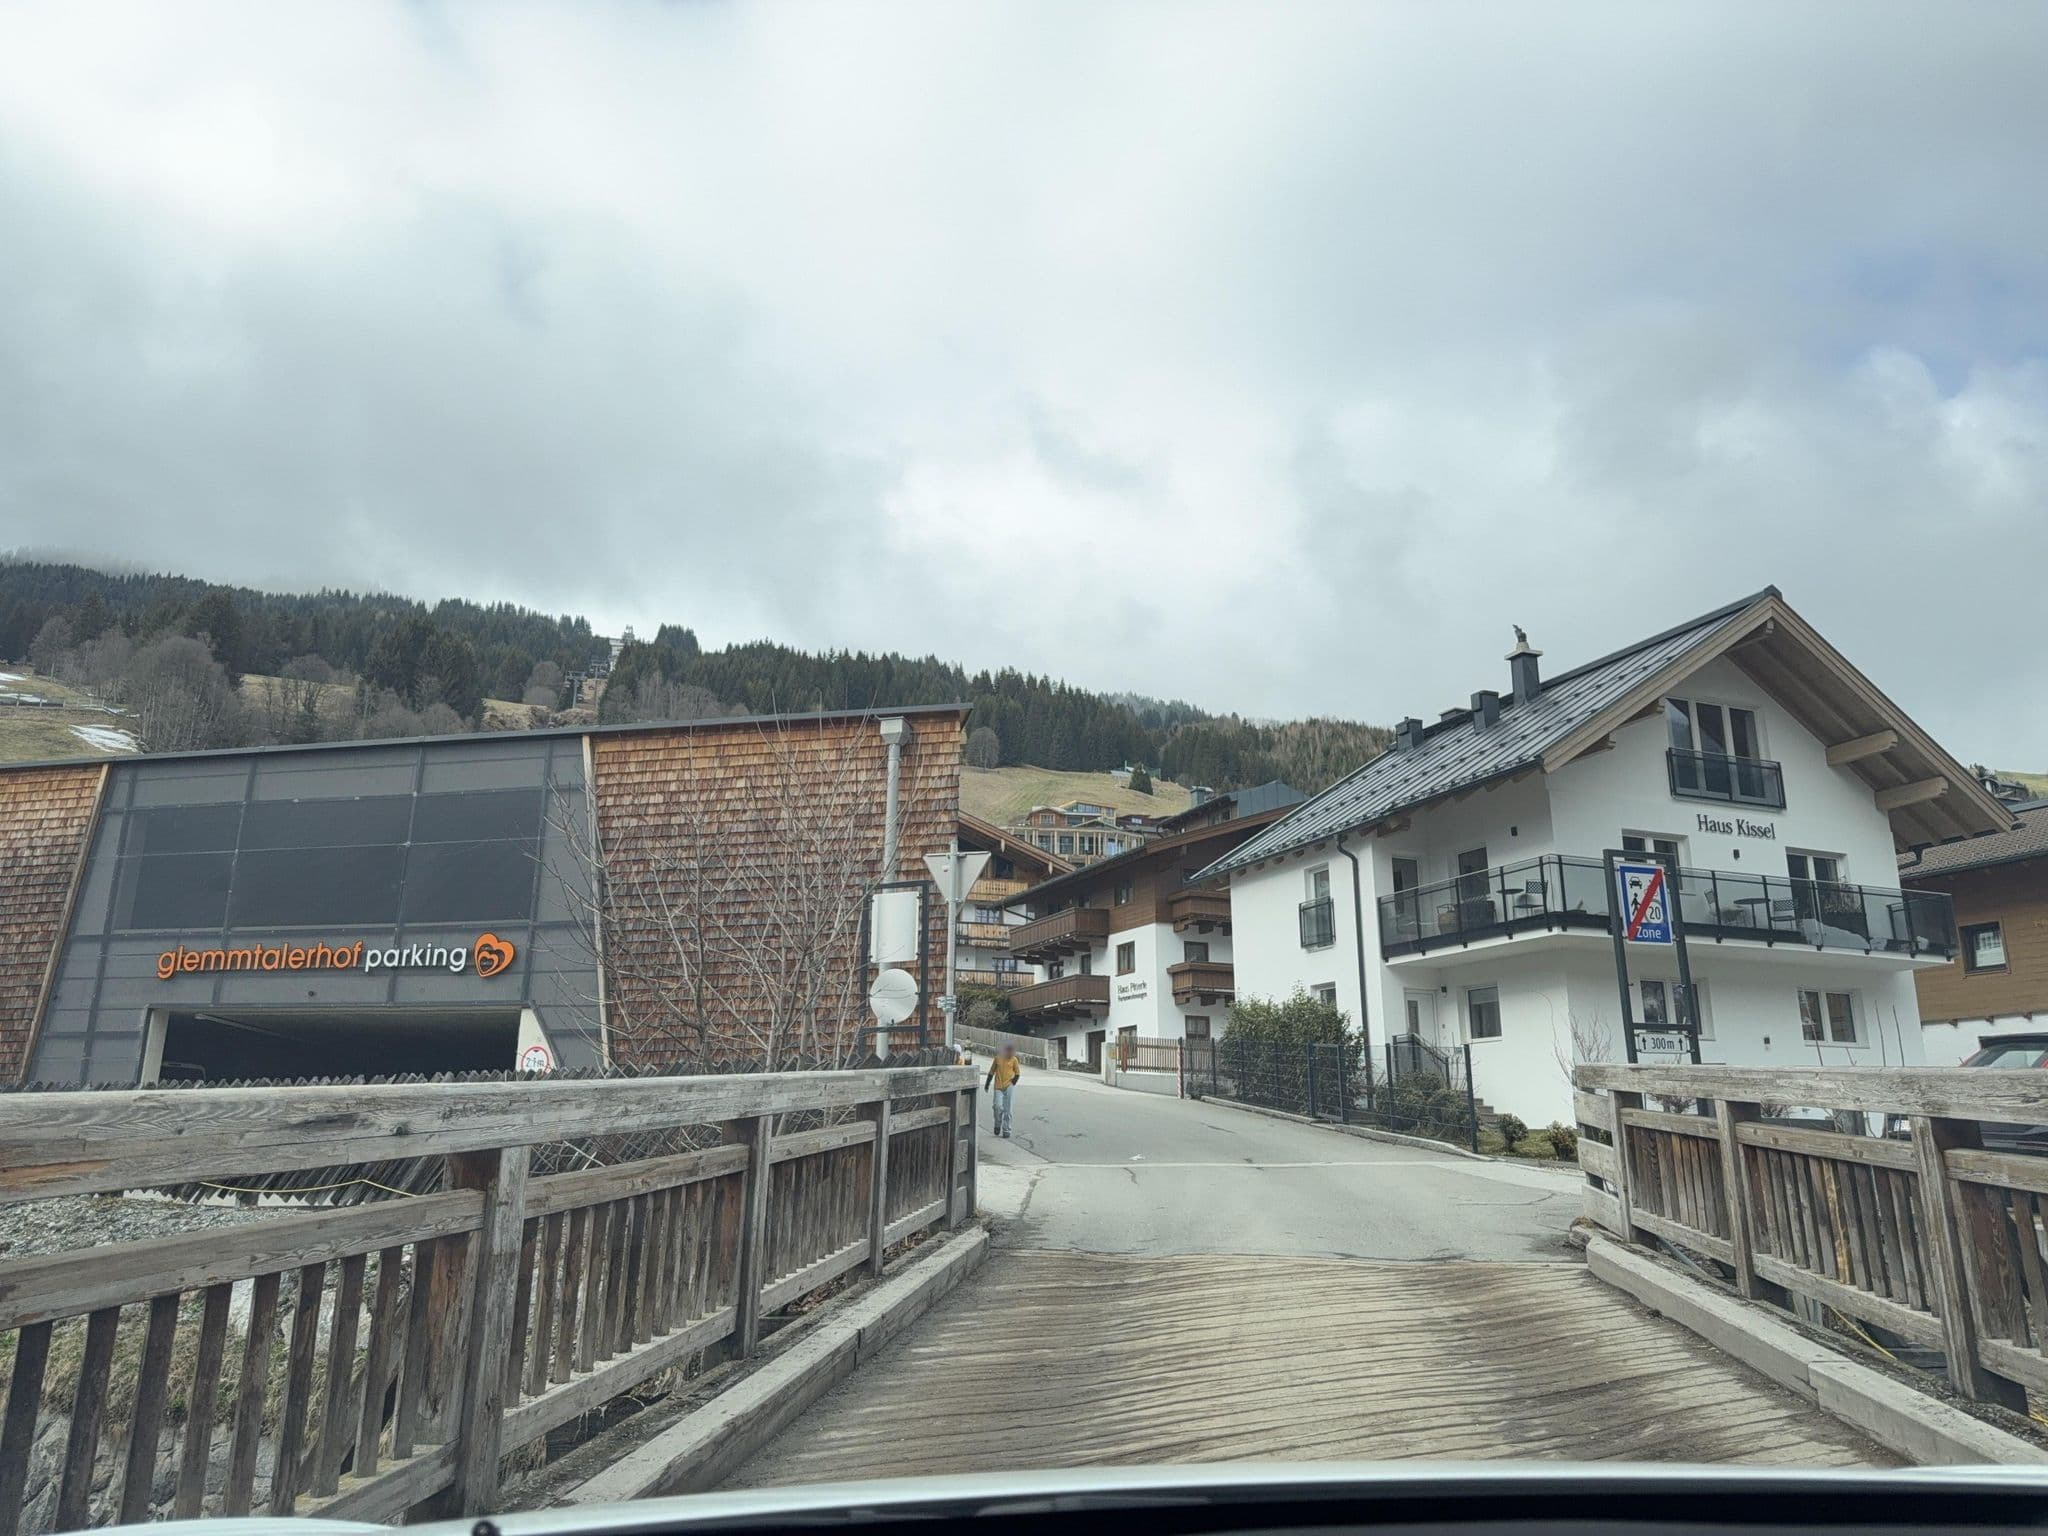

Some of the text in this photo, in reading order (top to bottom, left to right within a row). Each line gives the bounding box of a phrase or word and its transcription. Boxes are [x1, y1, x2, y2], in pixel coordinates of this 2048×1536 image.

[1696, 813, 1776, 839] Haus Kissel
[1648, 906, 1662, 920] 20
[1636, 926, 1662, 939] Zone
[157, 940, 468, 979] glemmtalerhof parking
[1650, 1037, 1676, 1050] 300m
